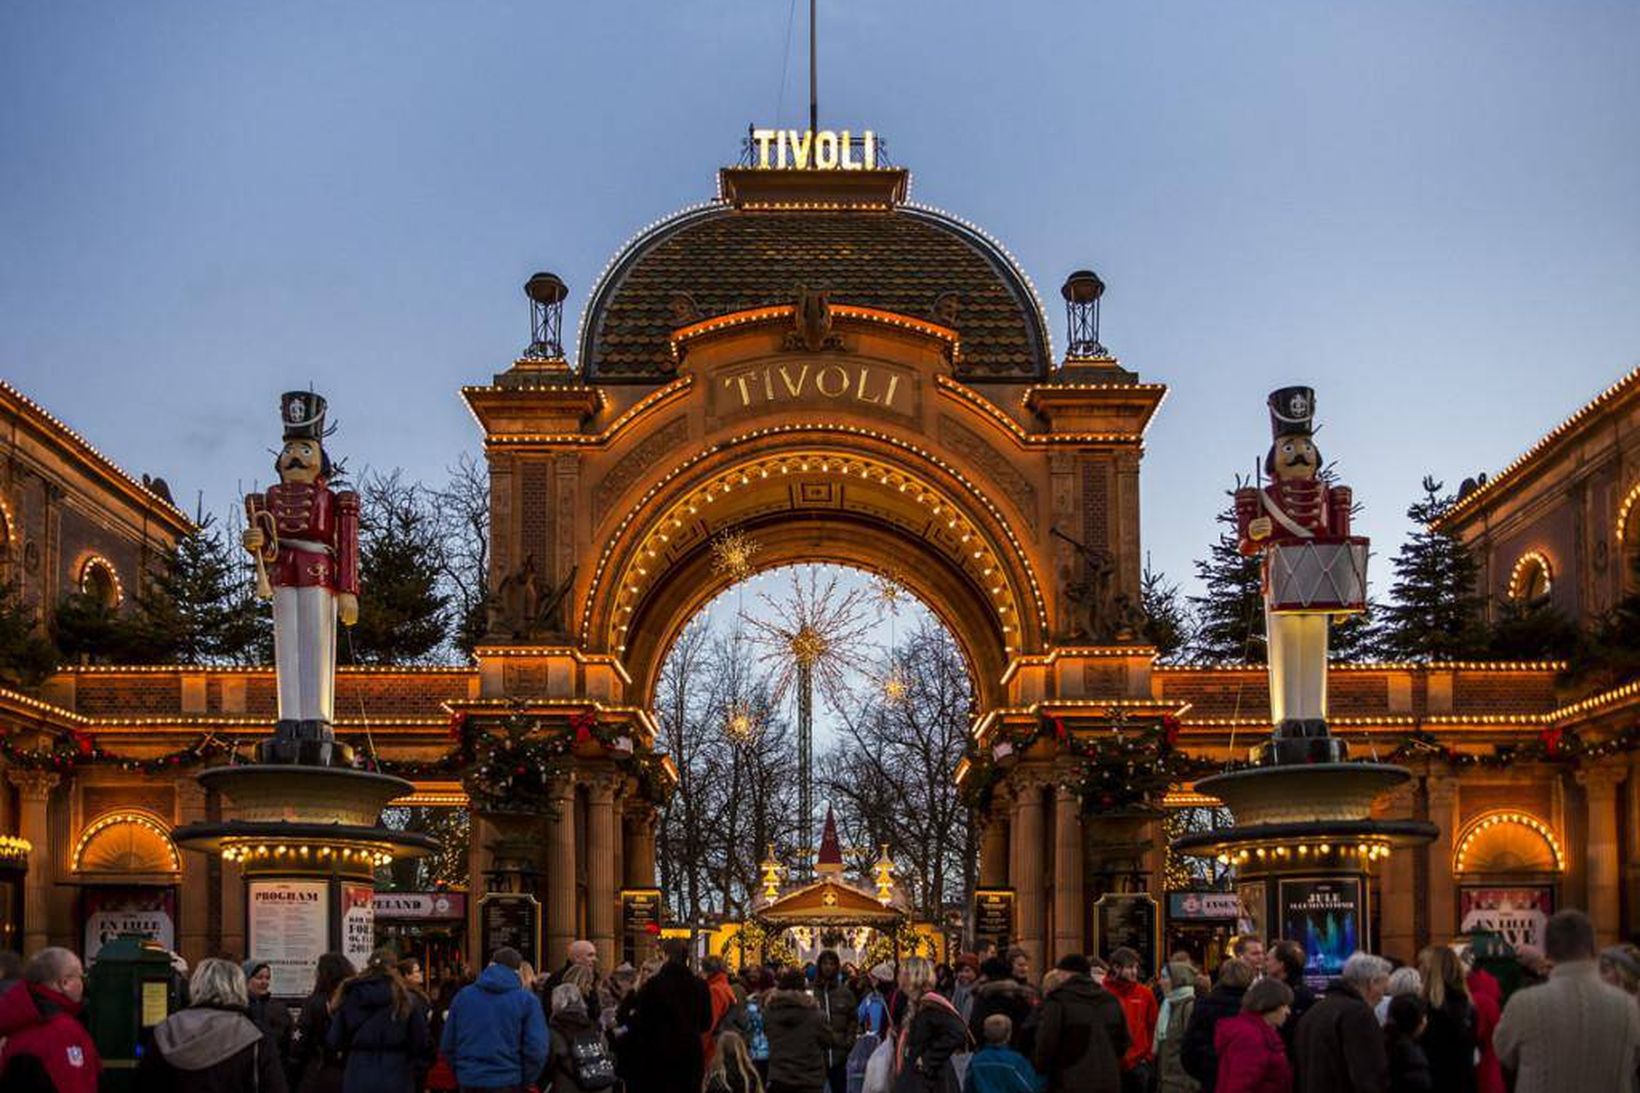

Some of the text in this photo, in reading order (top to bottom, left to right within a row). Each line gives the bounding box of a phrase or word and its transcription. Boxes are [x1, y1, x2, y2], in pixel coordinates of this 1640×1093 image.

[752, 129, 875, 172] TIVOLI
[724, 364, 899, 407] TIVOLI
[255, 891, 319, 902] PROGRAM
